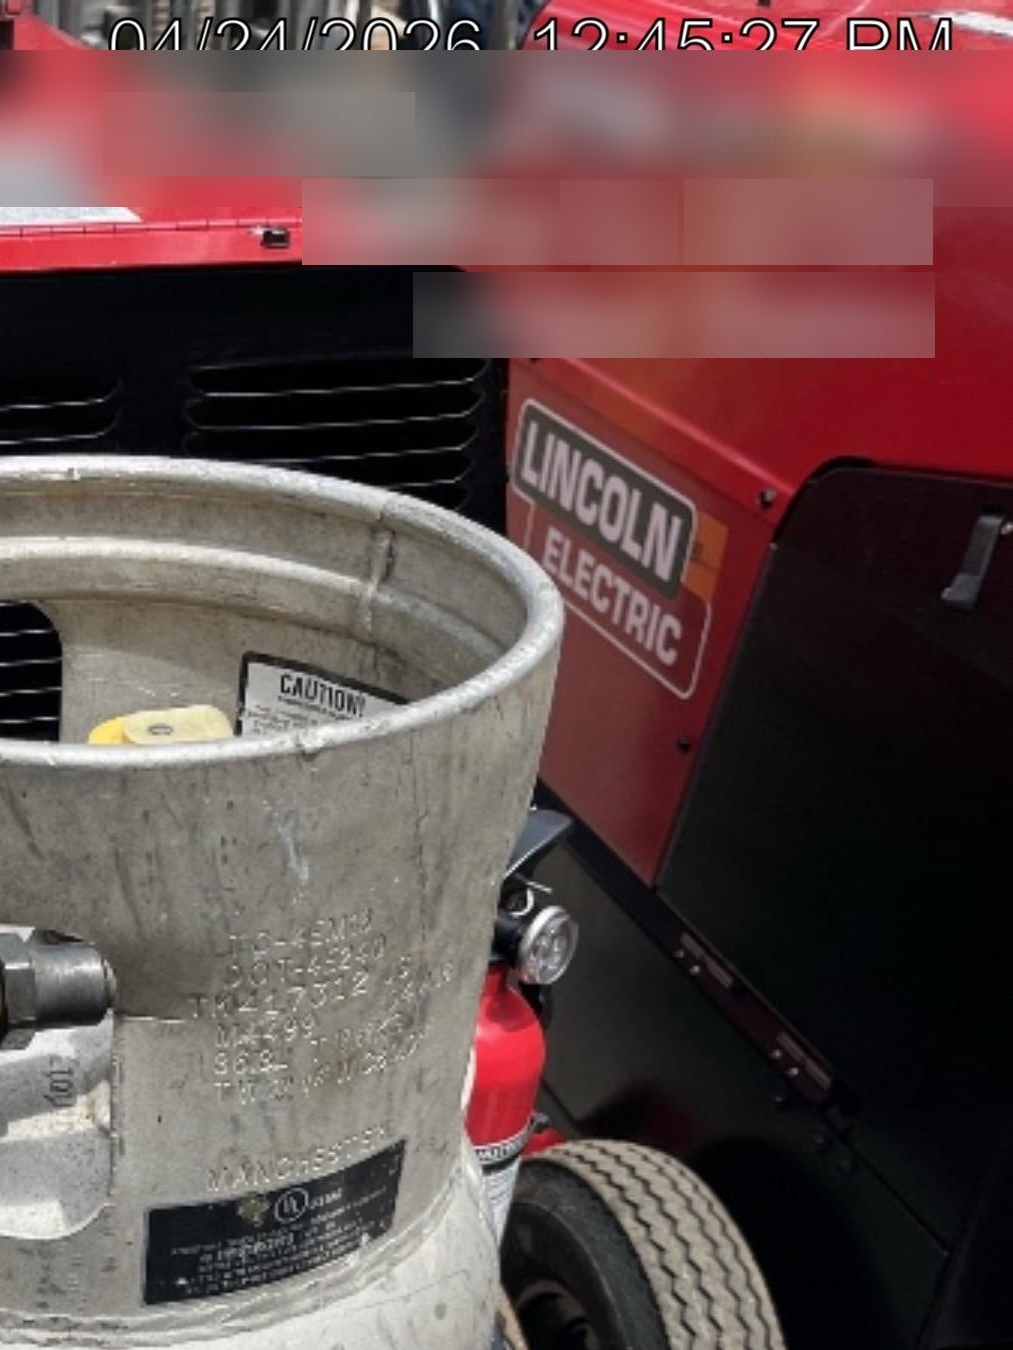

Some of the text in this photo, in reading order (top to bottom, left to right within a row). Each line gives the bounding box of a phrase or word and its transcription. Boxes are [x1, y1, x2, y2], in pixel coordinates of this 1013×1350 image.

[521, 421, 681, 582] LINCOLN
[542, 525, 682, 667] ELECTRIC
[280, 673, 366, 717] CAUTION!
